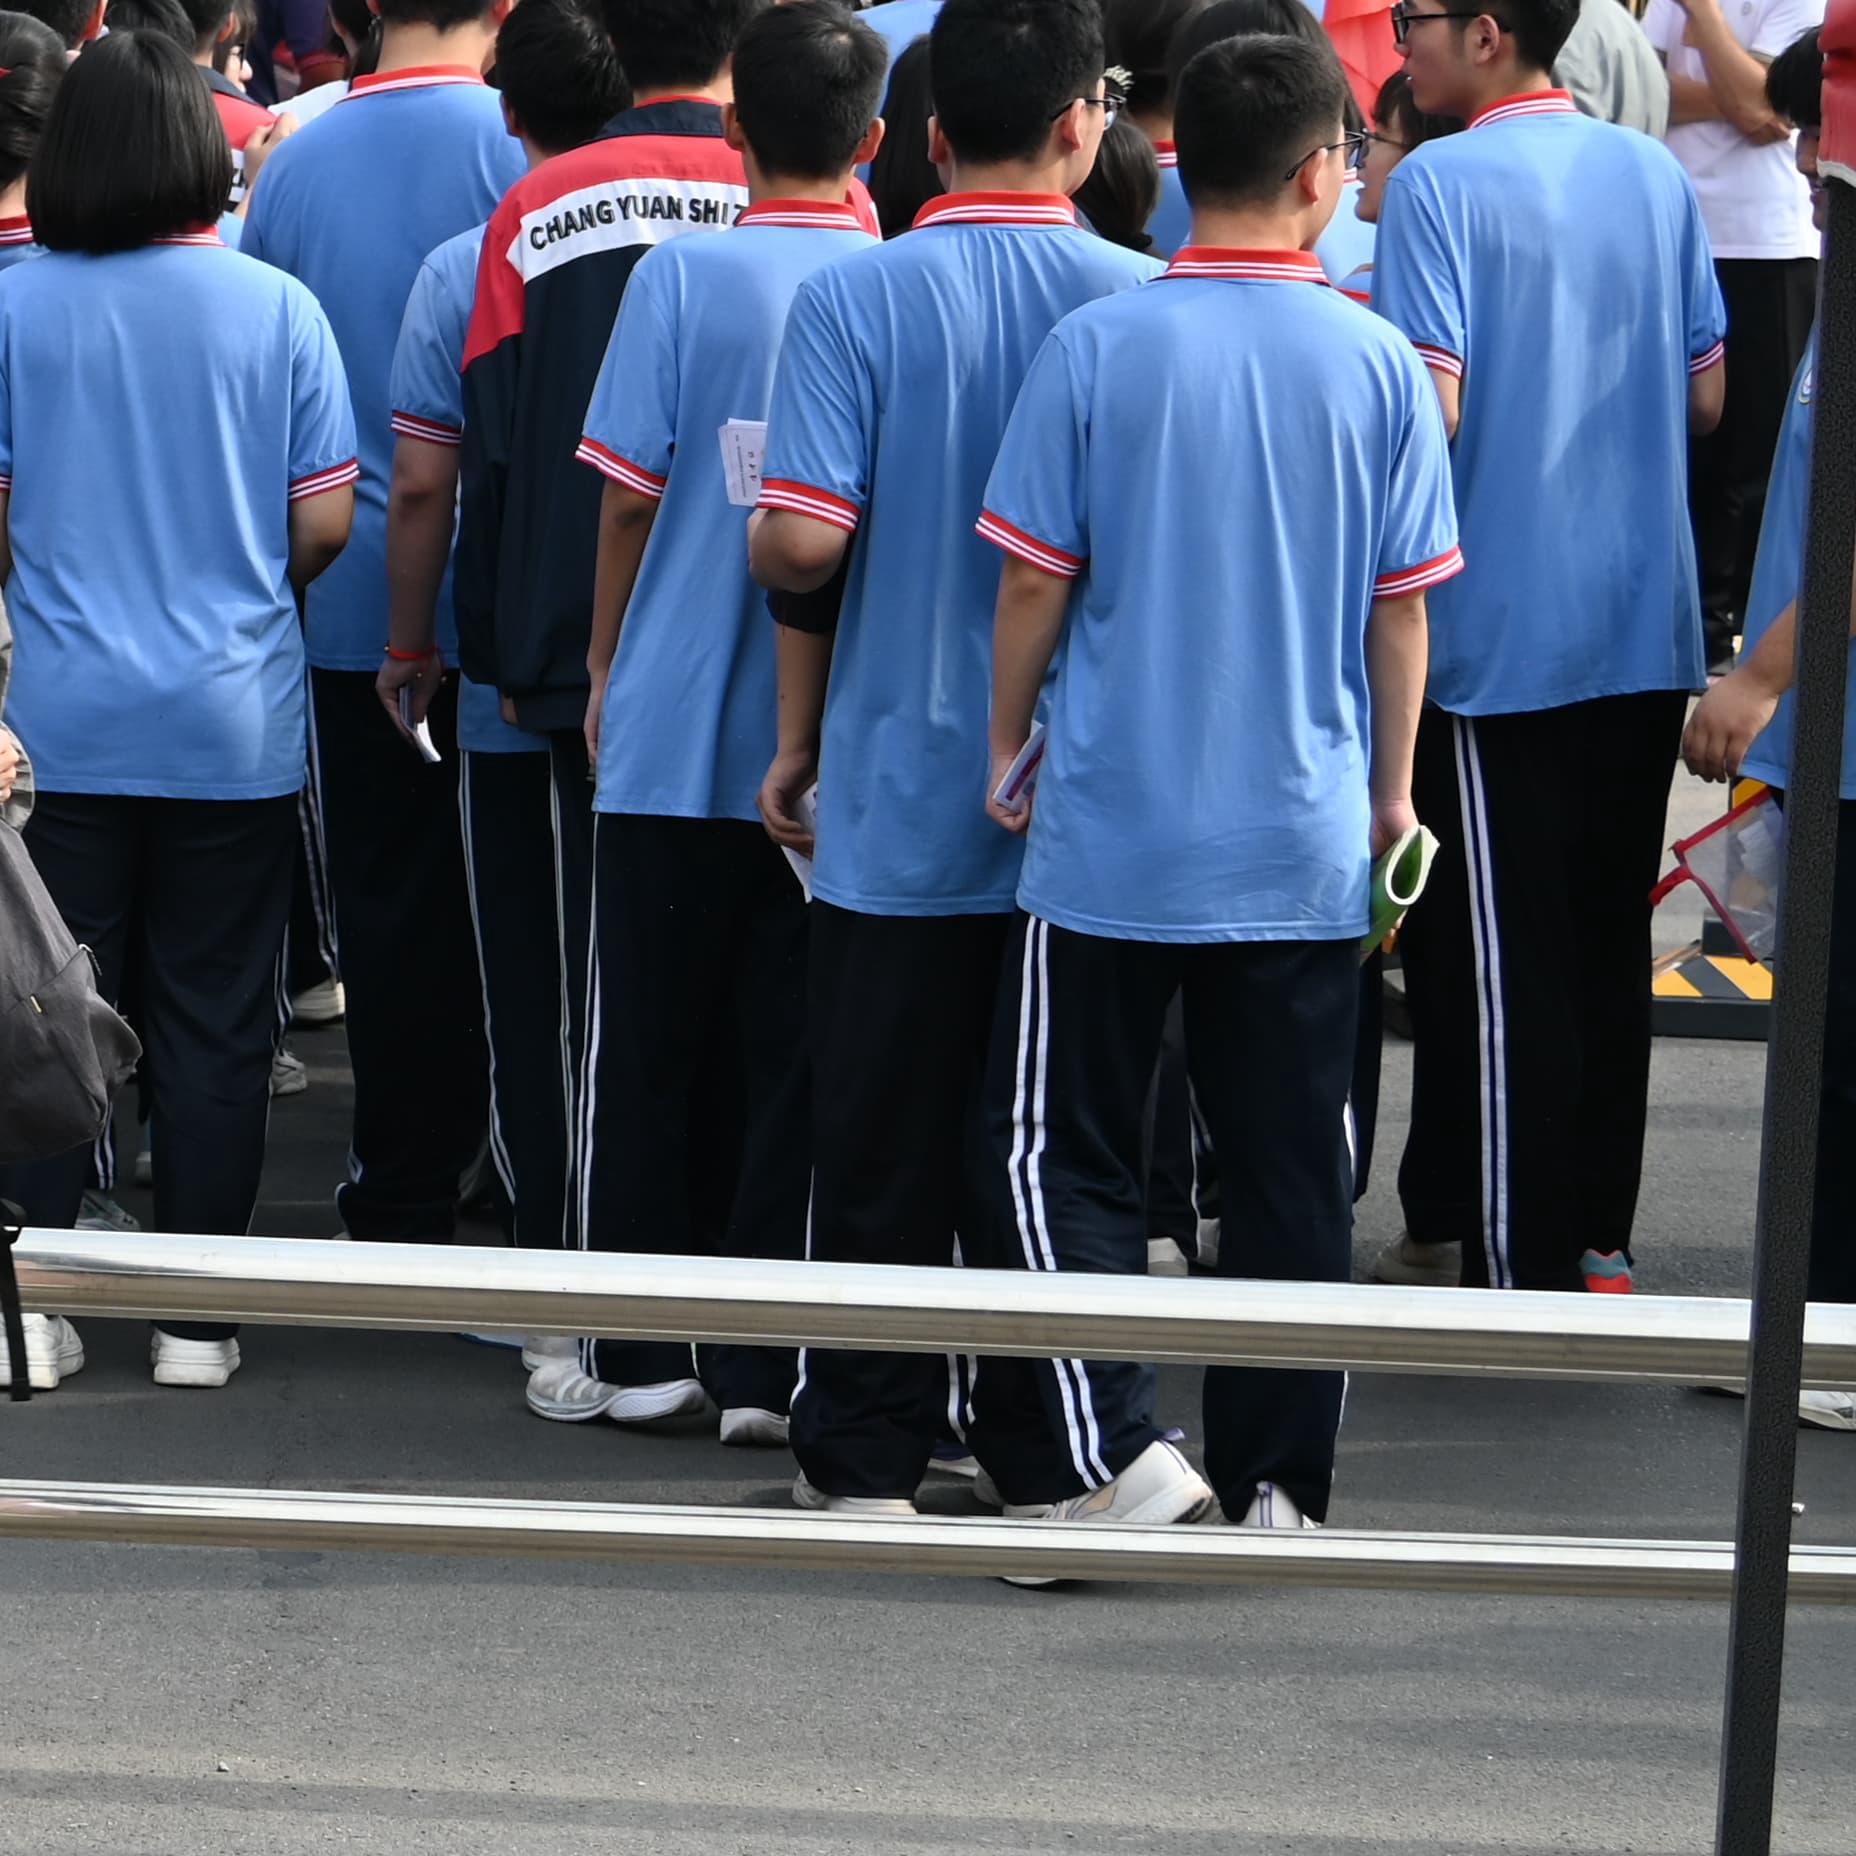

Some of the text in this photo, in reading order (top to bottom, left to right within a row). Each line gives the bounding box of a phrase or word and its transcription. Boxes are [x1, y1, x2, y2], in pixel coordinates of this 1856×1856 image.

[529, 199, 616, 250] CHANG
[616, 195, 684, 220] YUAN
[688, 197, 729, 225] SHI
